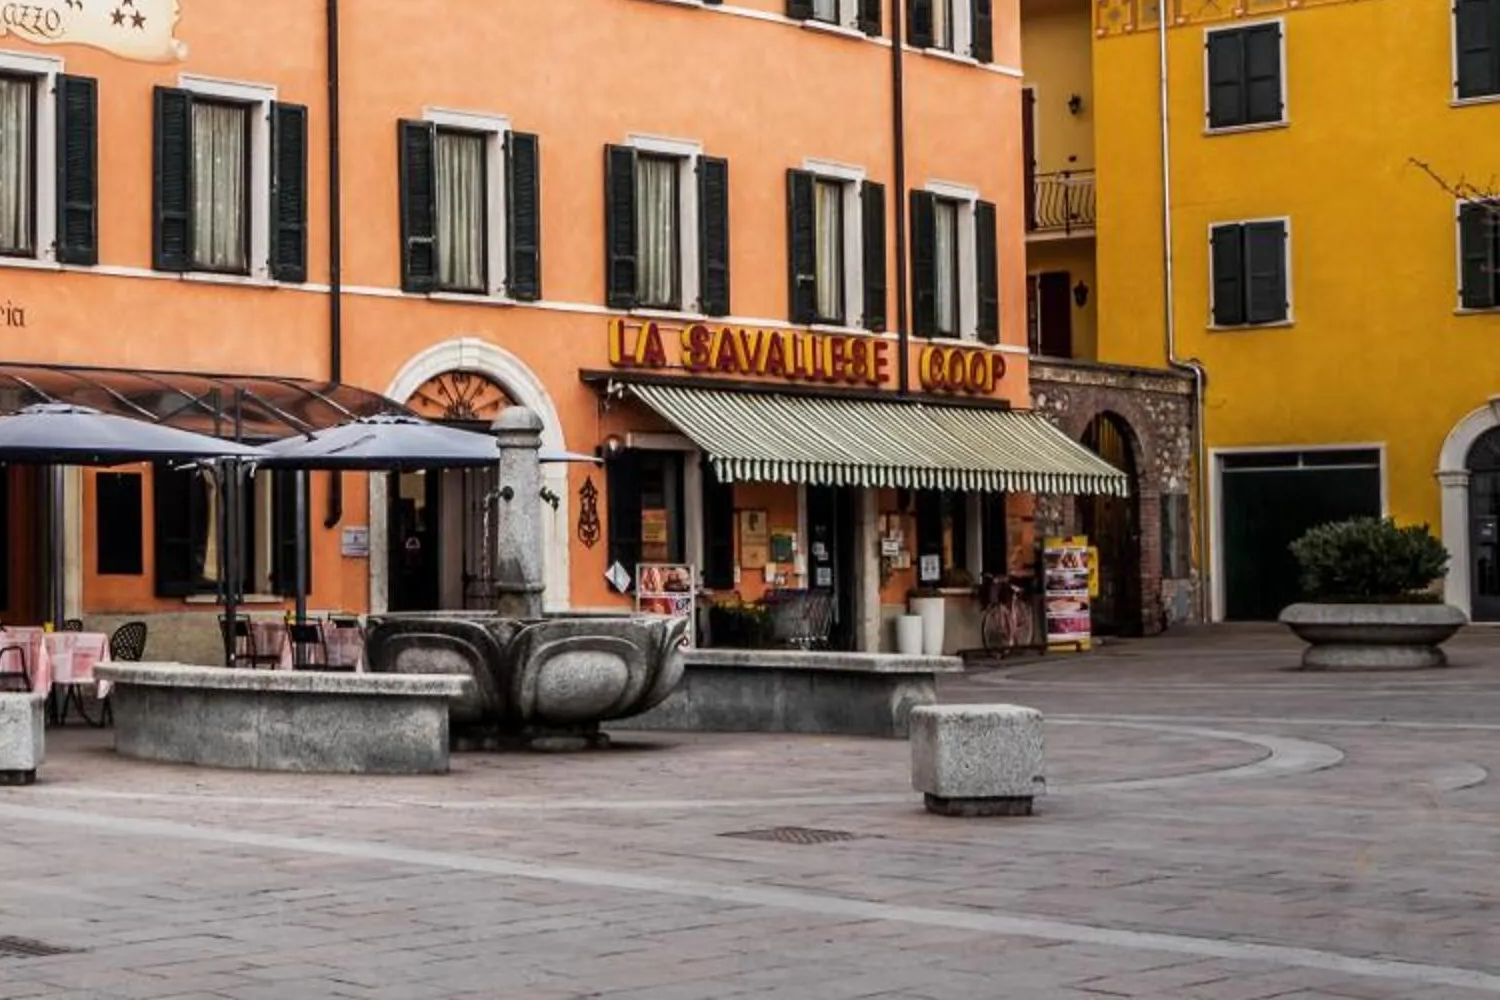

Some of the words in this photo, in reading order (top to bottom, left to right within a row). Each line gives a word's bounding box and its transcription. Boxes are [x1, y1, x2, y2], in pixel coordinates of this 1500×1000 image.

[608, 319, 667, 367] LA
[681, 324, 890, 385] SAVALLESE
[918, 345, 1006, 395] COOP
